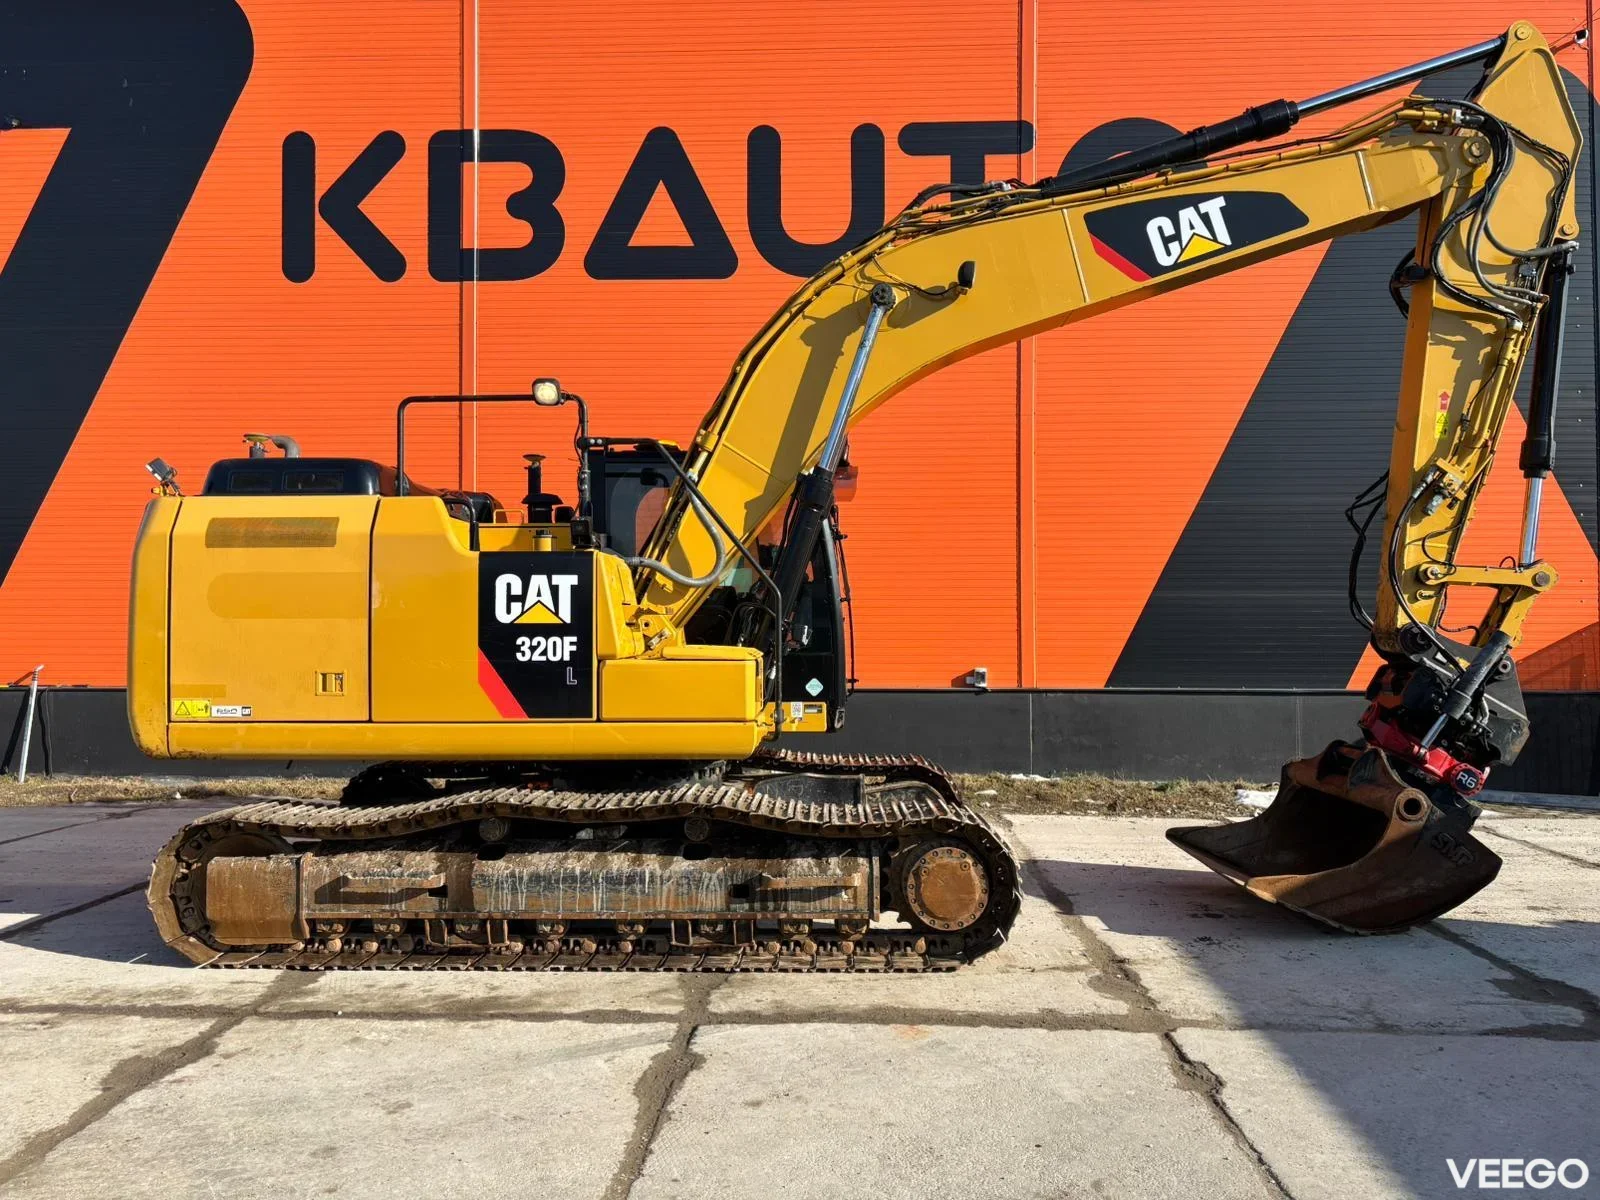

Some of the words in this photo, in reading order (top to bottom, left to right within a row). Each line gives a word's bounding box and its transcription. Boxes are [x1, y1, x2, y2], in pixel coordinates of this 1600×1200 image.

[1146, 196, 1232, 267] CAT
[495, 573, 578, 624] CAT
[515, 636, 578, 662] 320F
[566, 666, 578, 685] L
[1456, 771, 1477, 788] R6
